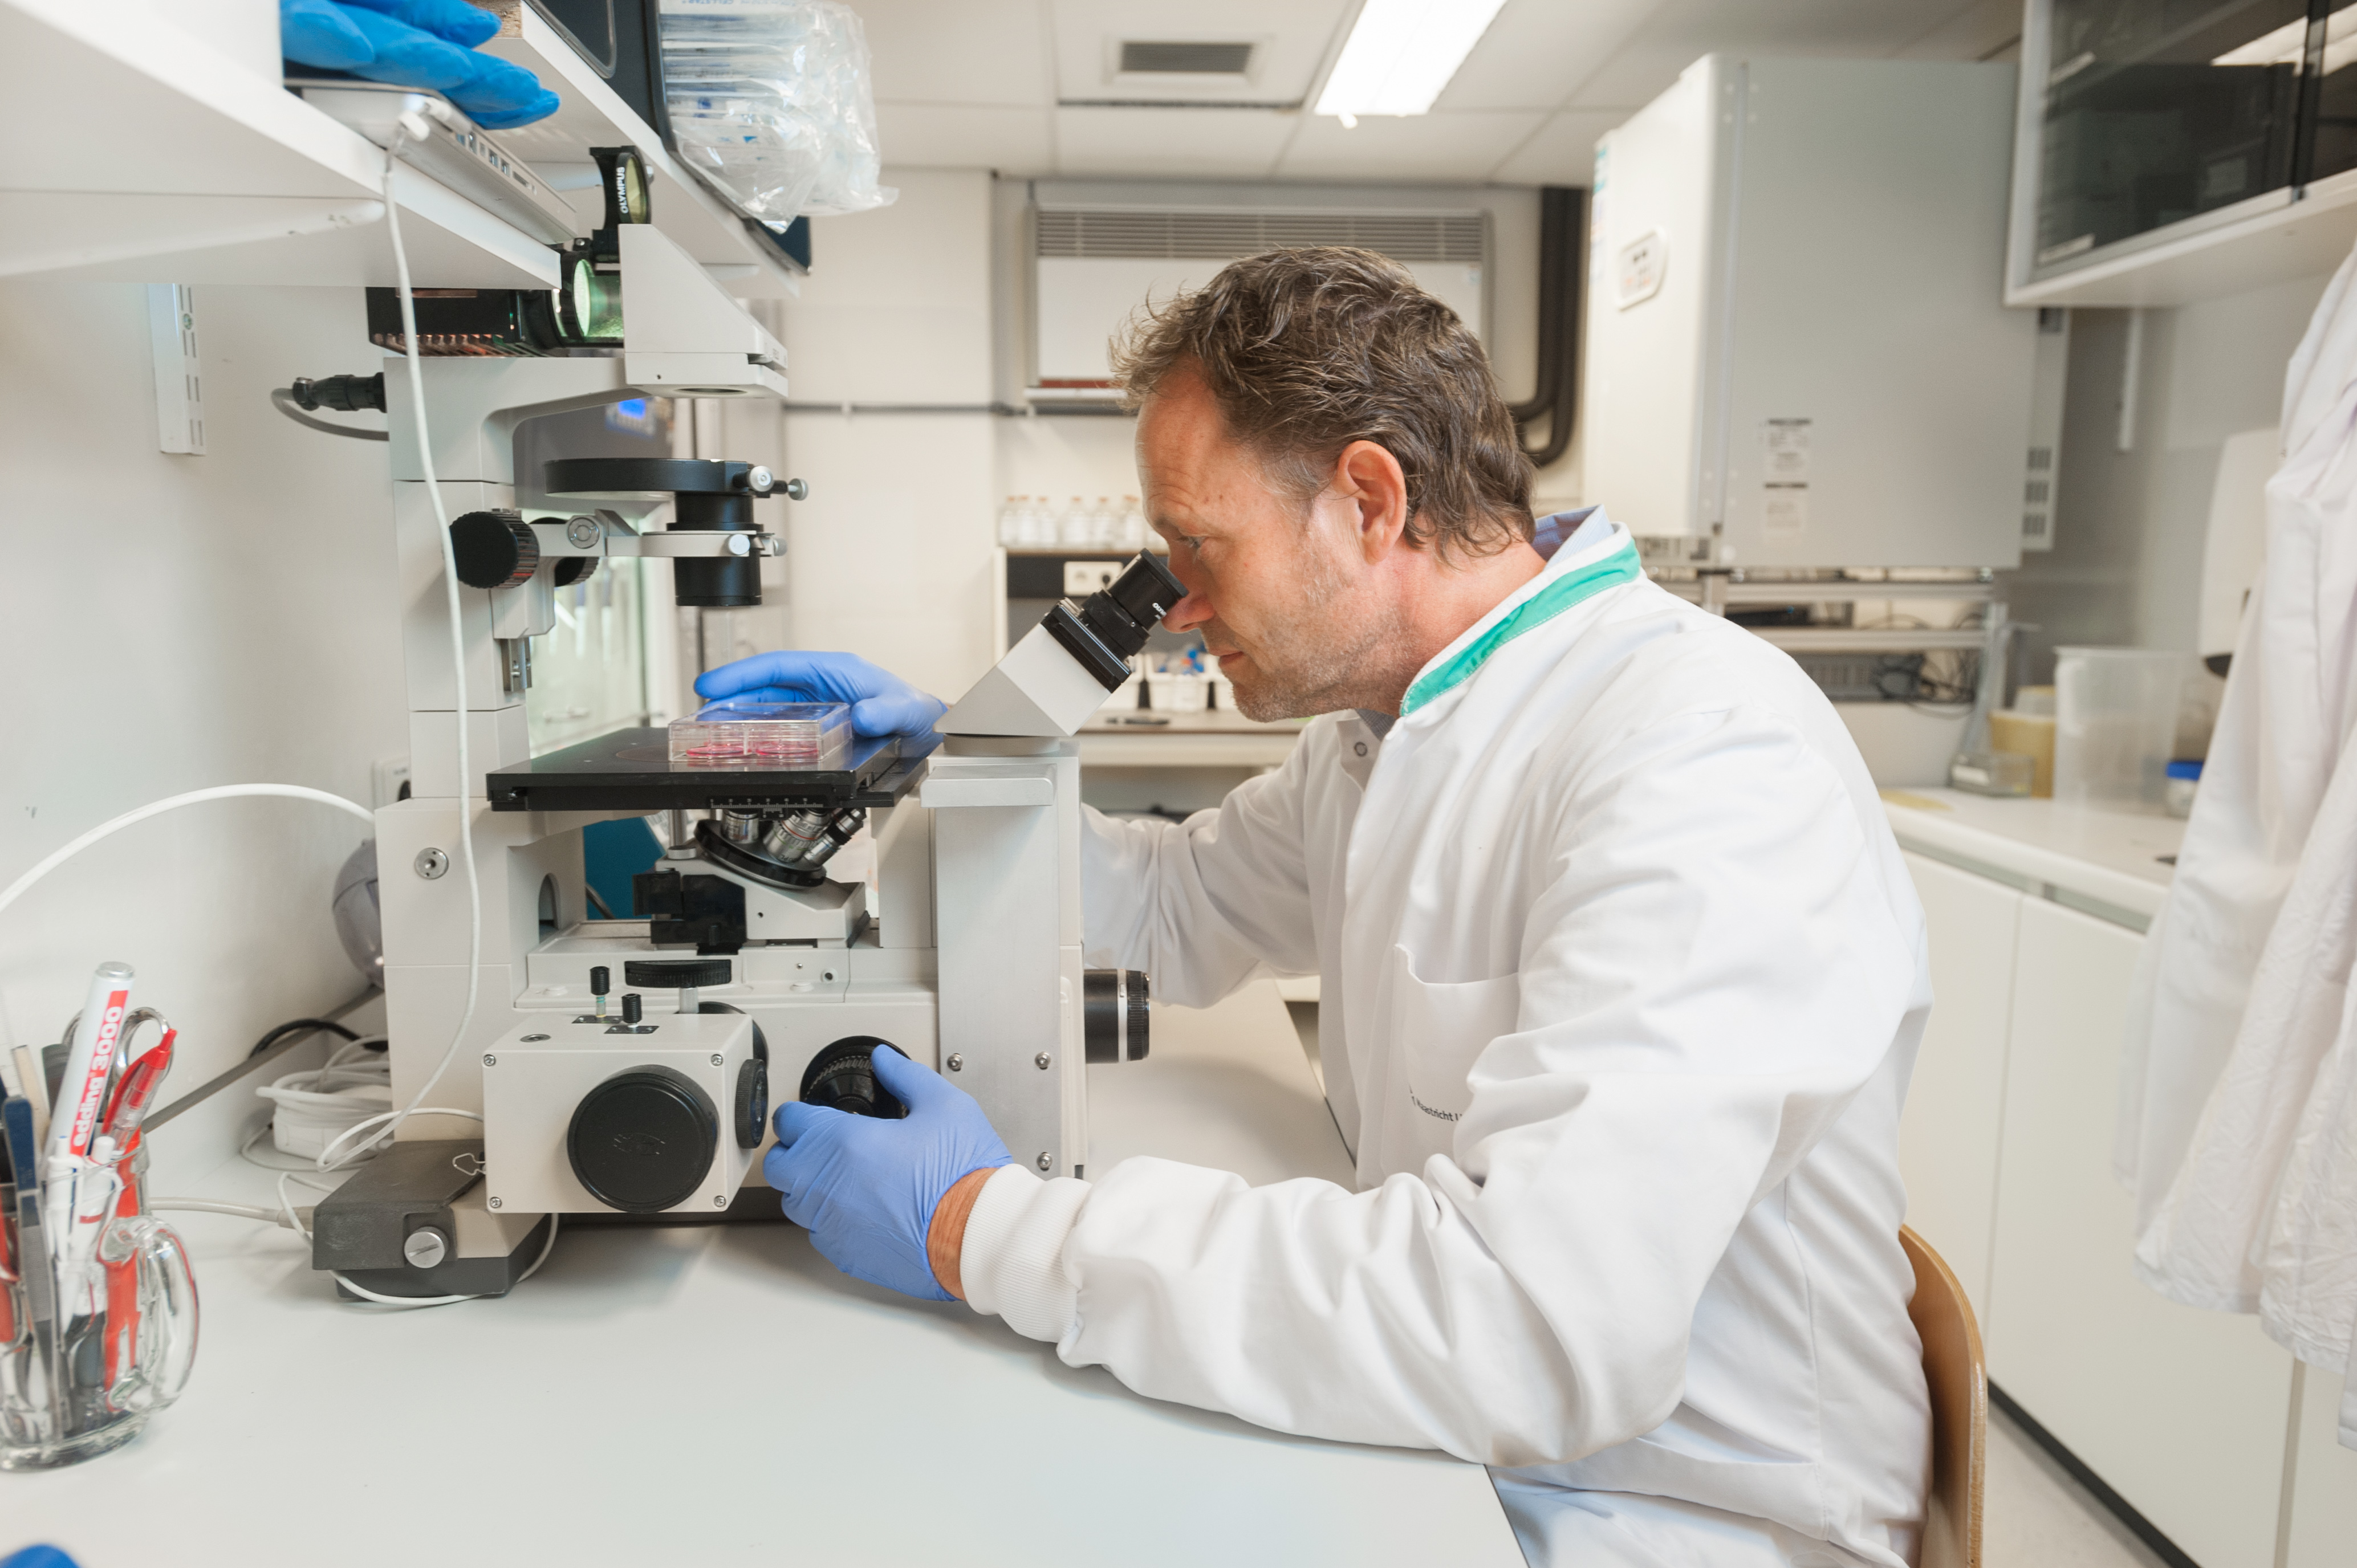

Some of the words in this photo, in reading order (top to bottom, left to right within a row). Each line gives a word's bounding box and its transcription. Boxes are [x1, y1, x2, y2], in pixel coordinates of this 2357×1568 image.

[616, 166, 629, 214] OLYMPUS
[1152, 602, 1167, 617] OLYM
[72, 1076, 104, 1147] edding
[91, 1006, 123, 1071] 3000
